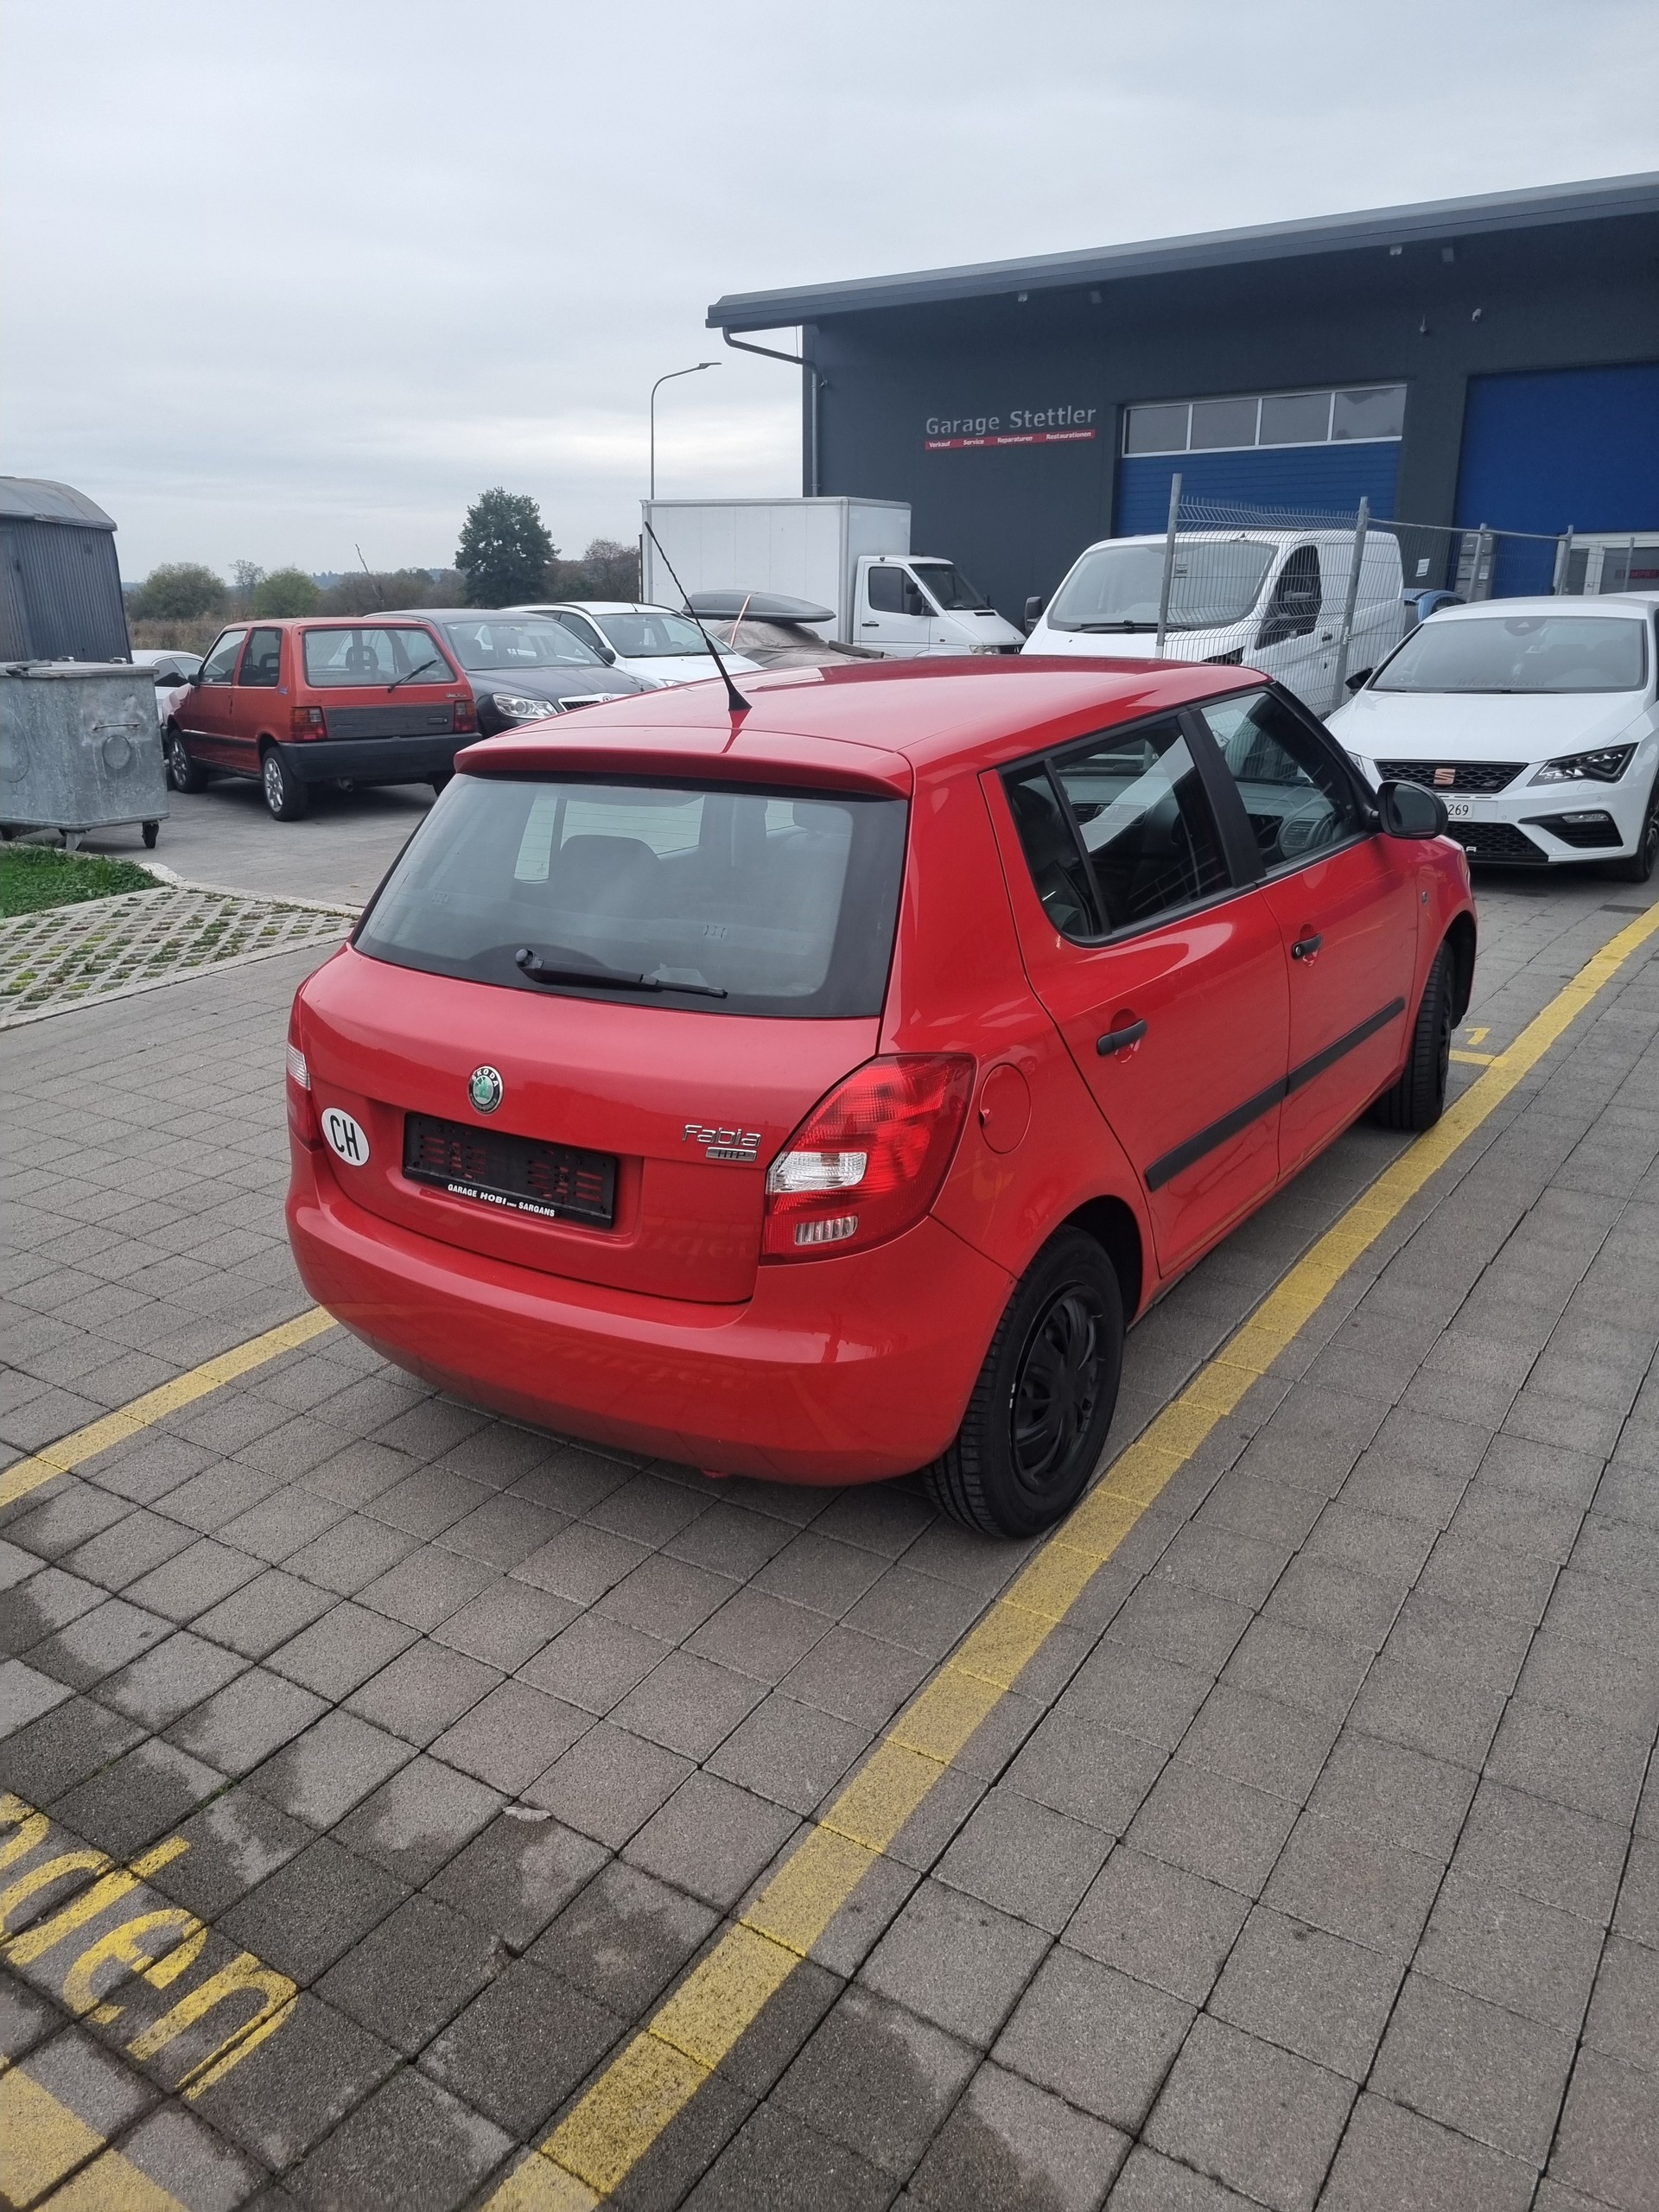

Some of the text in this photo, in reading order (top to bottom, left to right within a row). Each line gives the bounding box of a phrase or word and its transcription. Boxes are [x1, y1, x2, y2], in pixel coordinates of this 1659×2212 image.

[925, 405, 1096, 435] Garage Stettler
[997, 435, 1033, 444] Reparaturen
[1046, 431, 1092, 440] Restaurationen
[1448, 804, 1469, 816] 269
[329, 1115, 360, 1160] CH
[682, 1124, 761, 1147] Fabia
[717, 1149, 747, 1159] HTP
[448, 1184, 478, 1198] GARAGE
[480, 1192, 506, 1205] HOBI
[518, 1202, 556, 1217] SARGANS
